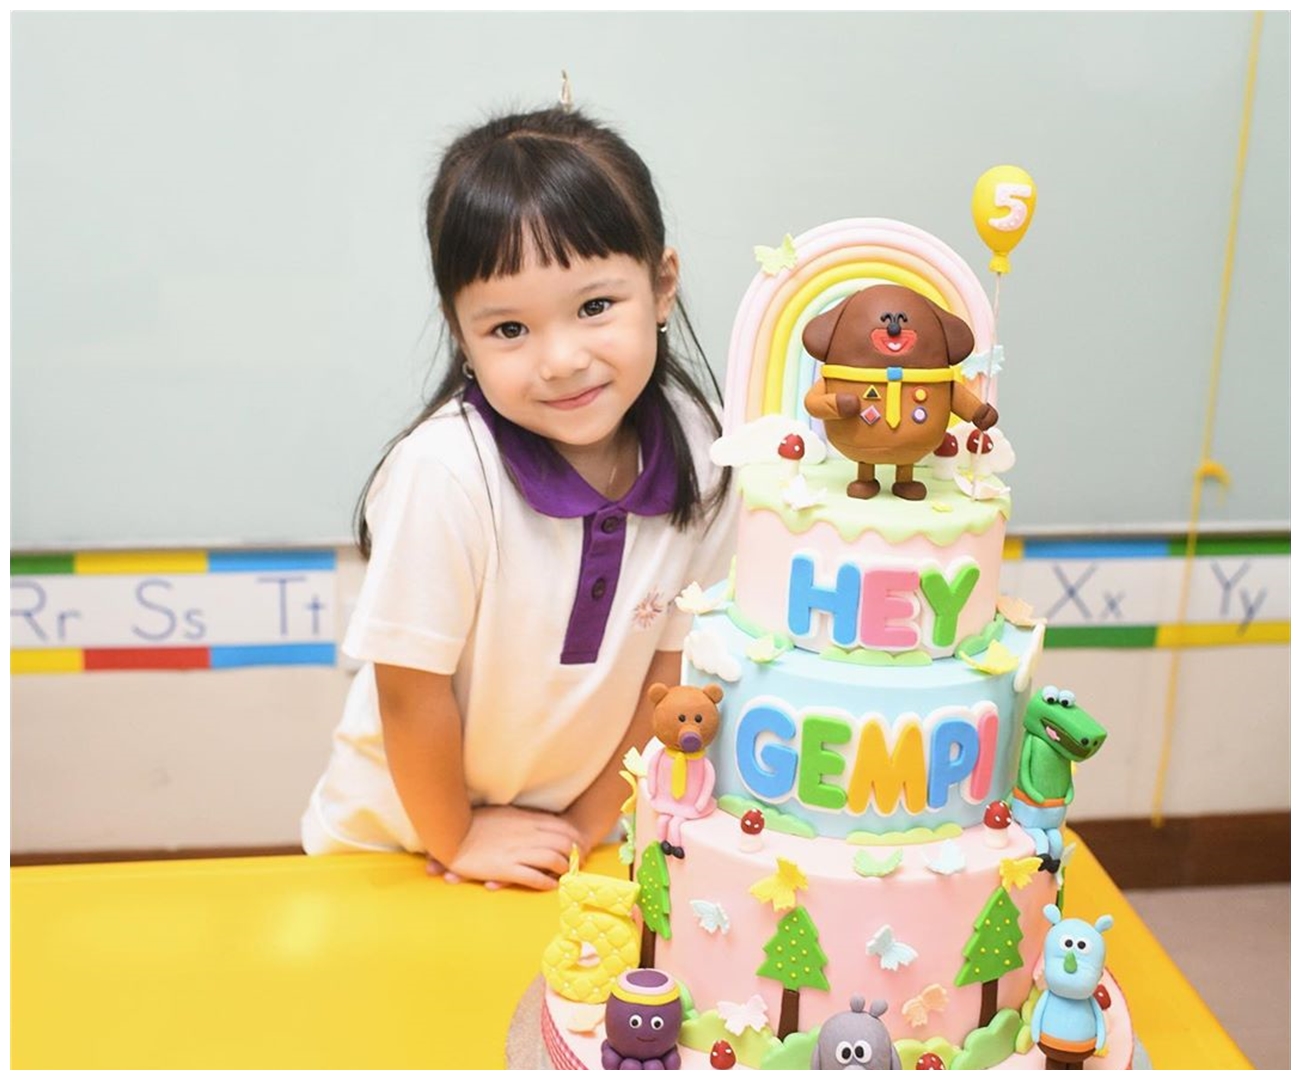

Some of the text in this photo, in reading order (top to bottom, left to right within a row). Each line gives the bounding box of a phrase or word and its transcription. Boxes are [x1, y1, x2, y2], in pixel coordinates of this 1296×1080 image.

[988, 183, 1032, 232] 5
[132, 578, 207, 641] Ss
[256, 575, 326, 637] Tt
[787, 553, 980, 649] HEY
[1045, 559, 1268, 637] Xx Yy
[735, 703, 999, 815] GEMPI
[541, 871, 641, 1005] 5
